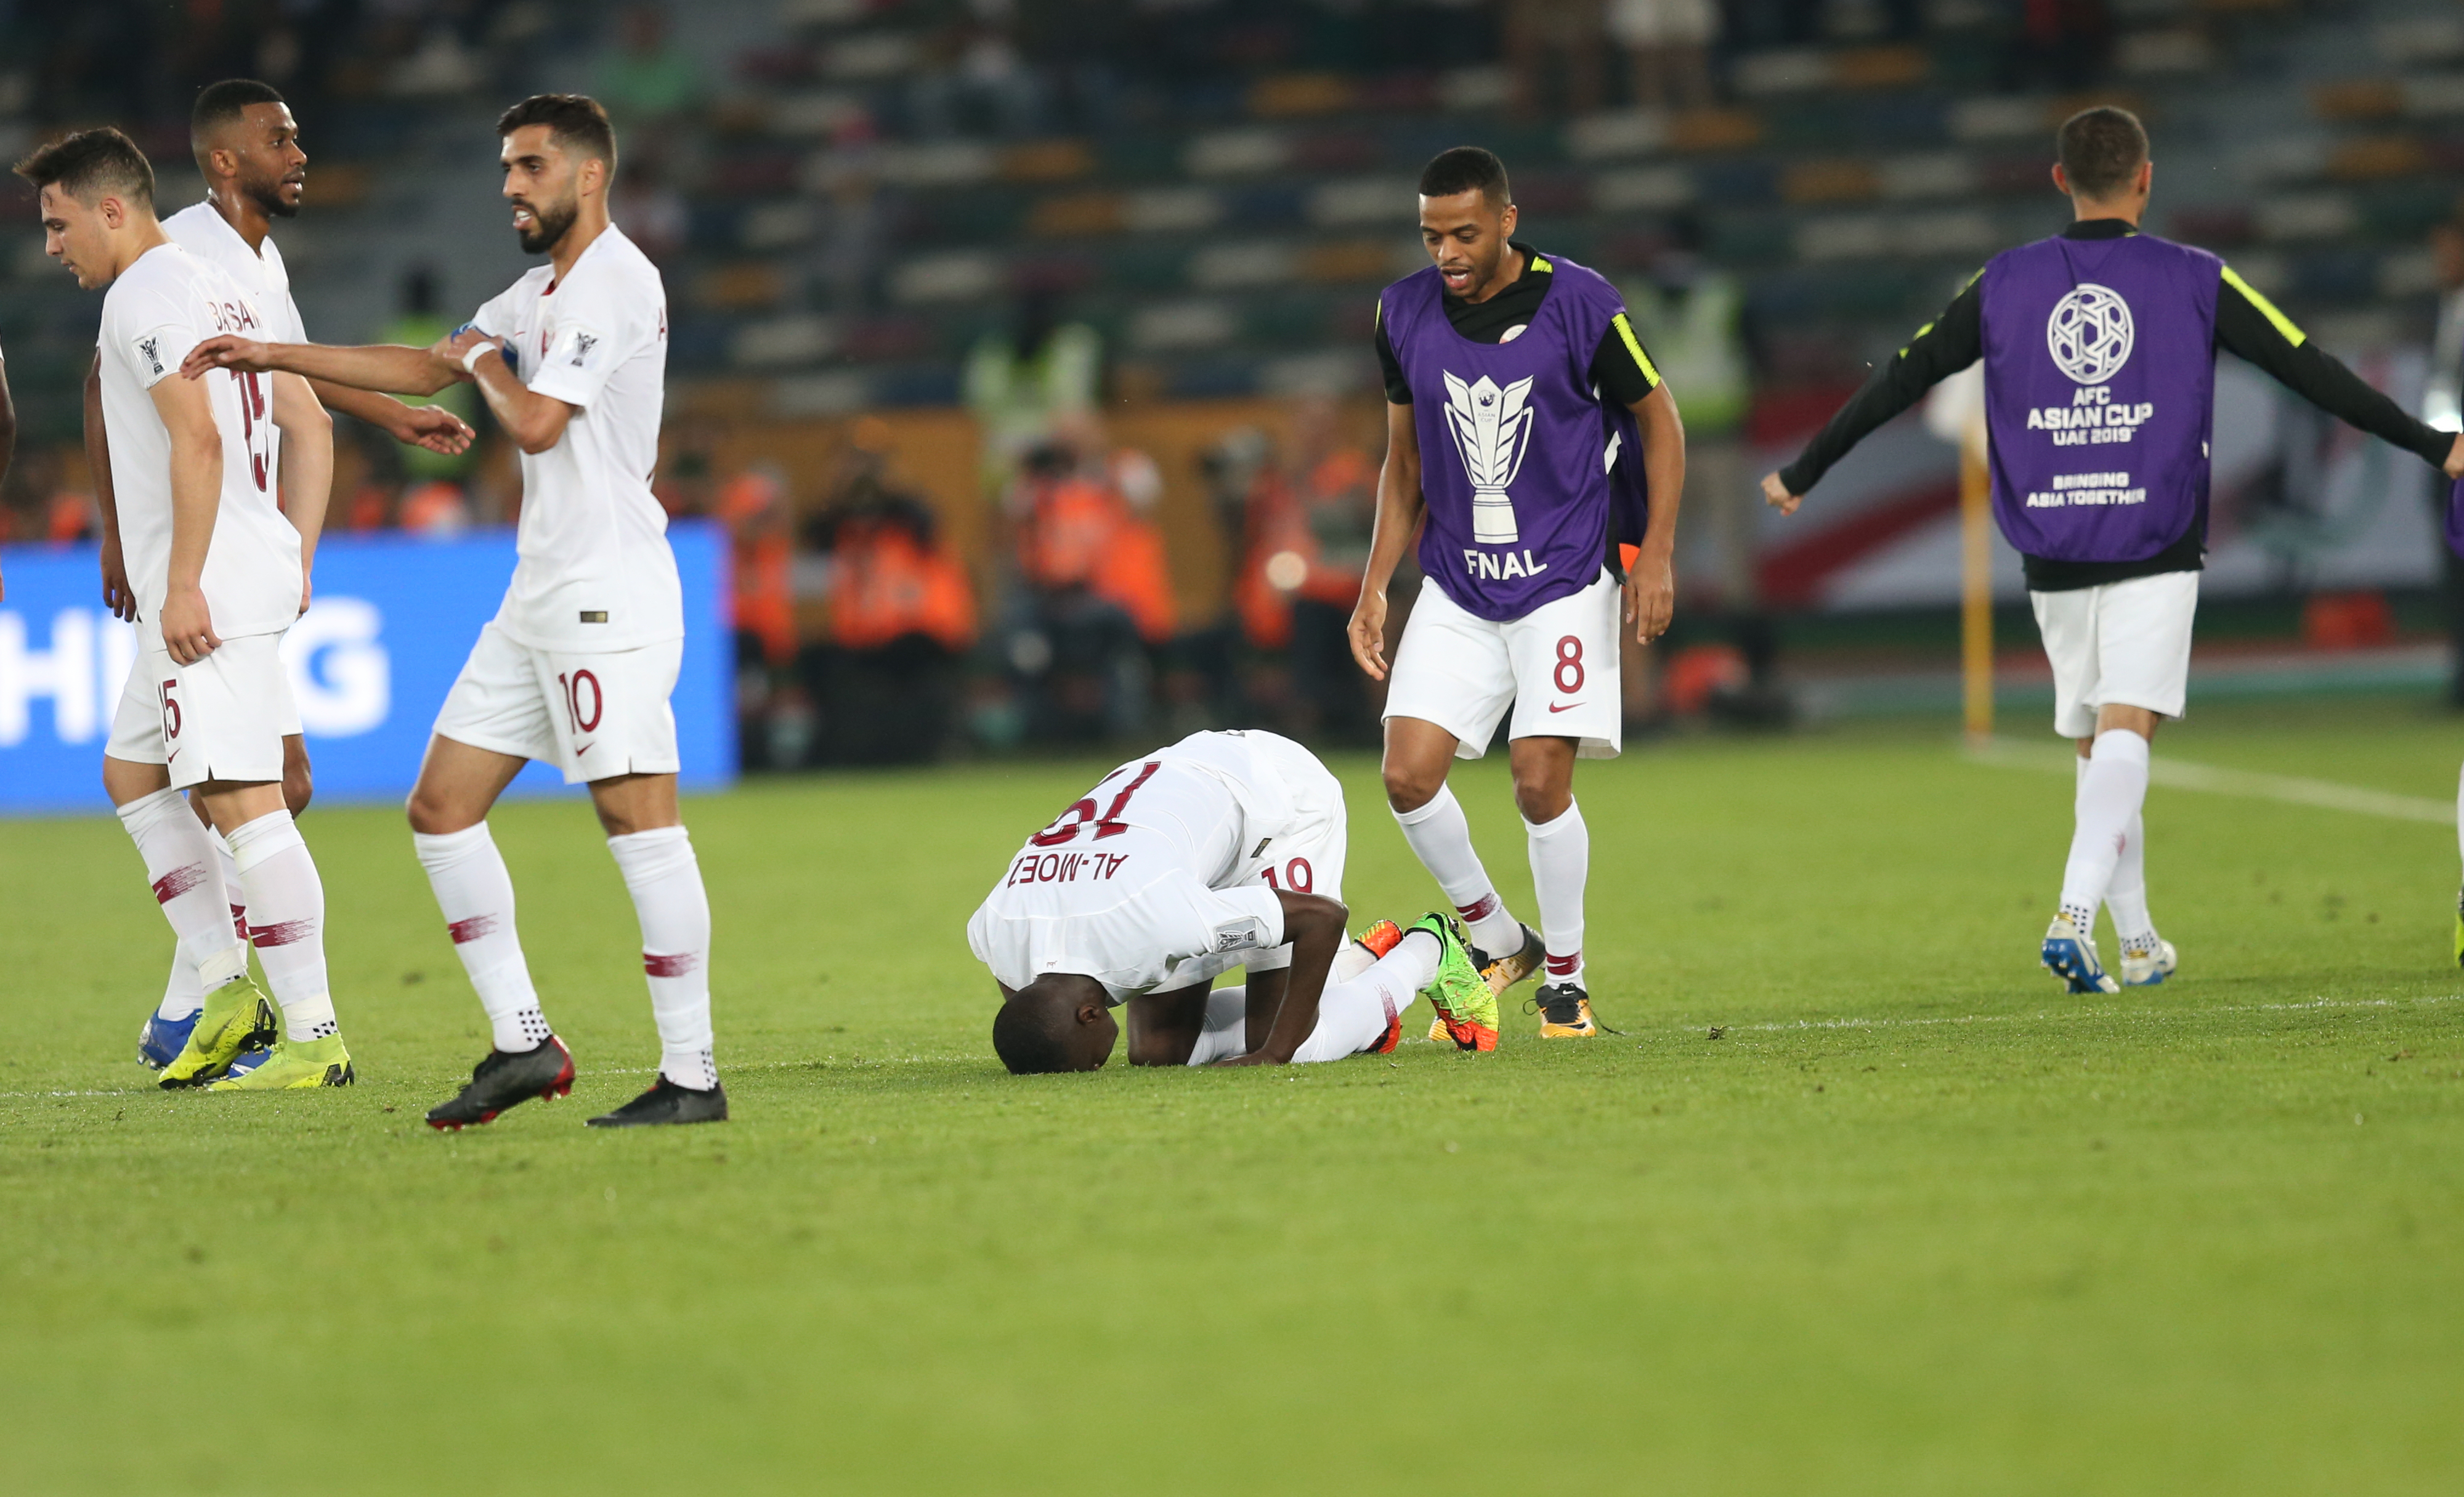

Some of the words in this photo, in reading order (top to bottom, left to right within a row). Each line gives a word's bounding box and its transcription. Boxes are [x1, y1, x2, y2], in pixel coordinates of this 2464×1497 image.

[2072, 386, 2111, 407] AFC
[2027, 406, 2102, 430] ASIAN
[2105, 402, 2154, 426] CUP
[2053, 430, 2088, 446] UAE
[2053, 471, 2130, 490] BRINGING
[2026, 492, 2065, 508] ASIA
[1463, 549, 1548, 580] FNAL
[1554, 635, 1584, 694] 8
[158, 679, 181, 742] 15
[559, 669, 602, 735] 10
